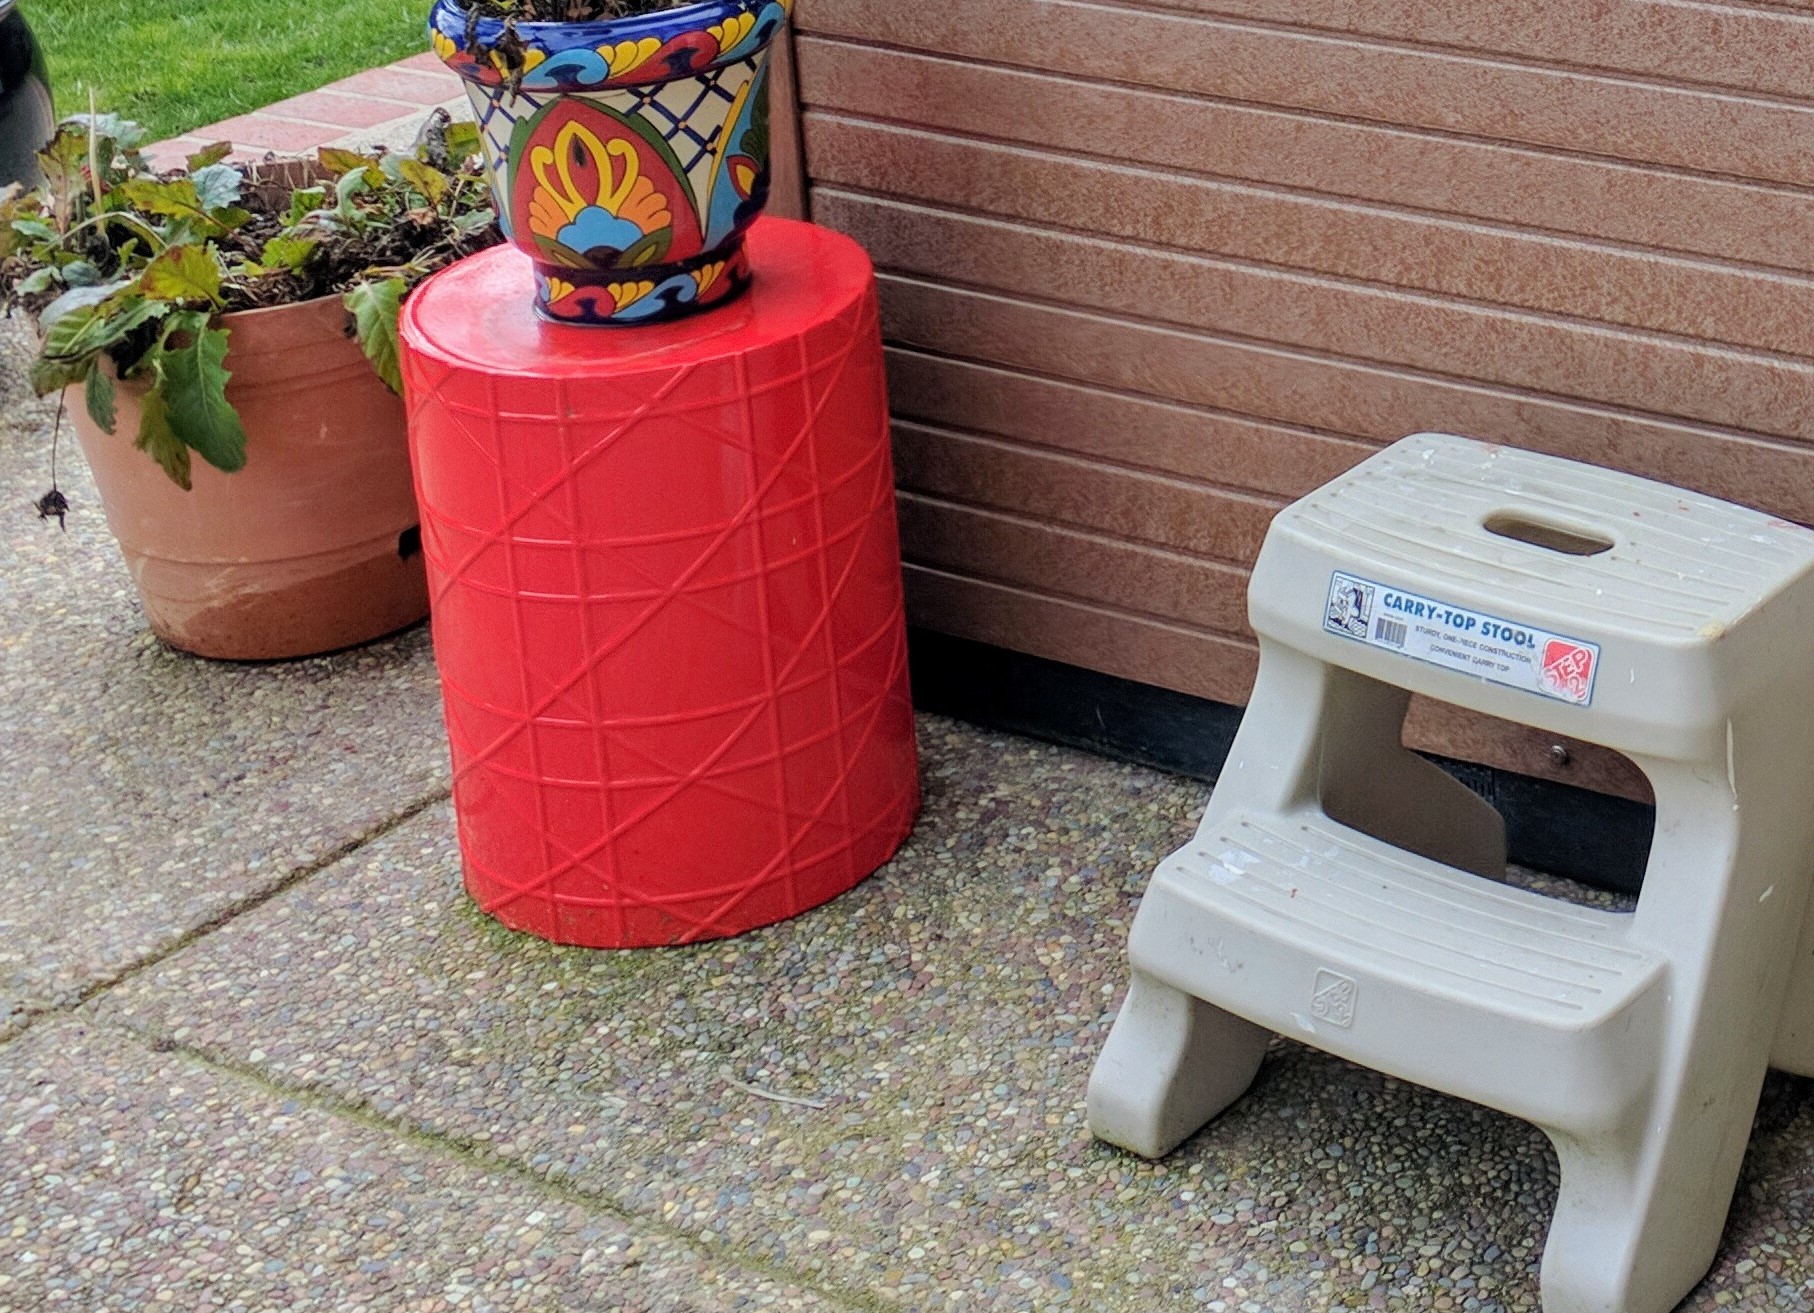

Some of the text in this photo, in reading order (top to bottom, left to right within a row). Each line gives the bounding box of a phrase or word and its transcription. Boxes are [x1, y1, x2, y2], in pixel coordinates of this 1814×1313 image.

[1383, 592, 1536, 649] CARRY-TOP STOOL
[1430, 644, 1510, 673] CONVENIENT CARRY TOP
[1479, 643, 1532, 664] CONSTRUCTION
[1542, 648, 1588, 687] STEP
[1568, 675, 1587, 699] 2
